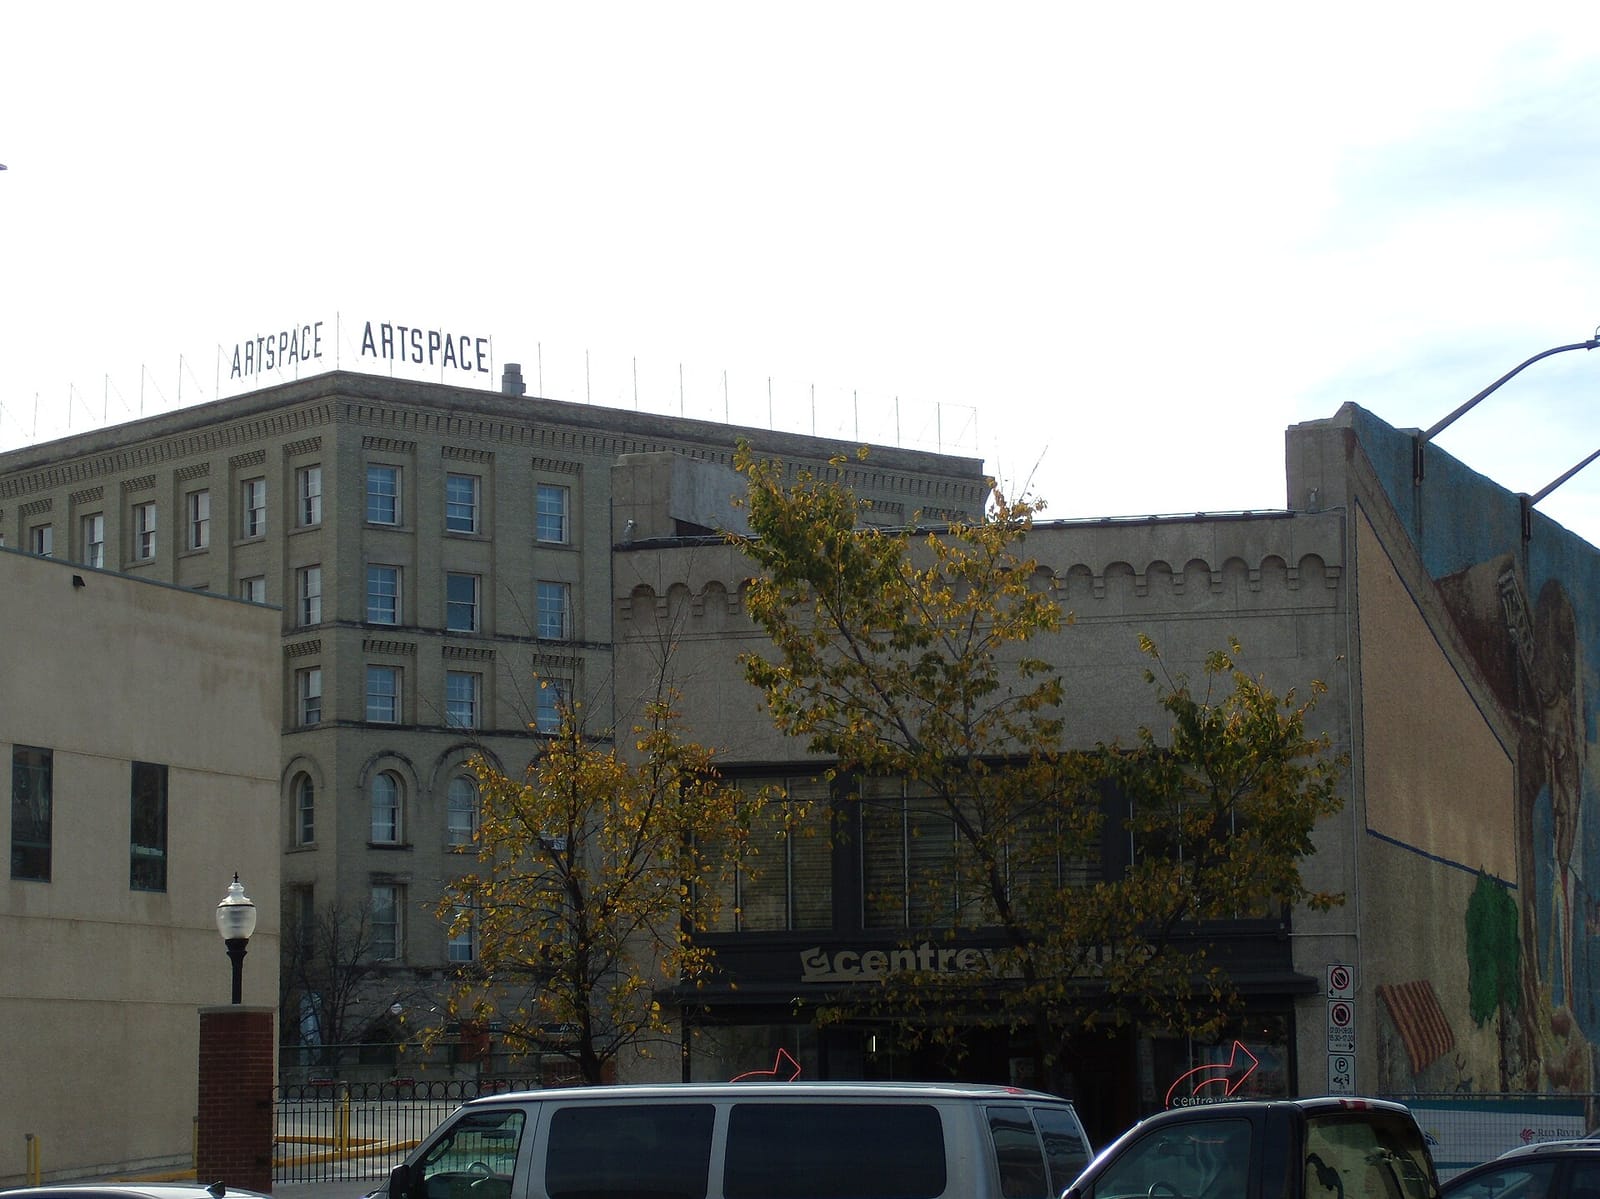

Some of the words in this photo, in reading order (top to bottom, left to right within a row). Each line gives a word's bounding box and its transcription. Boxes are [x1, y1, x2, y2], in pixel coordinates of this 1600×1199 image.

[231, 321, 323, 379] ARTSPACE
[361, 320, 489, 373] ARTSPACE
[1557, 1128, 1581, 1136] RIVER
